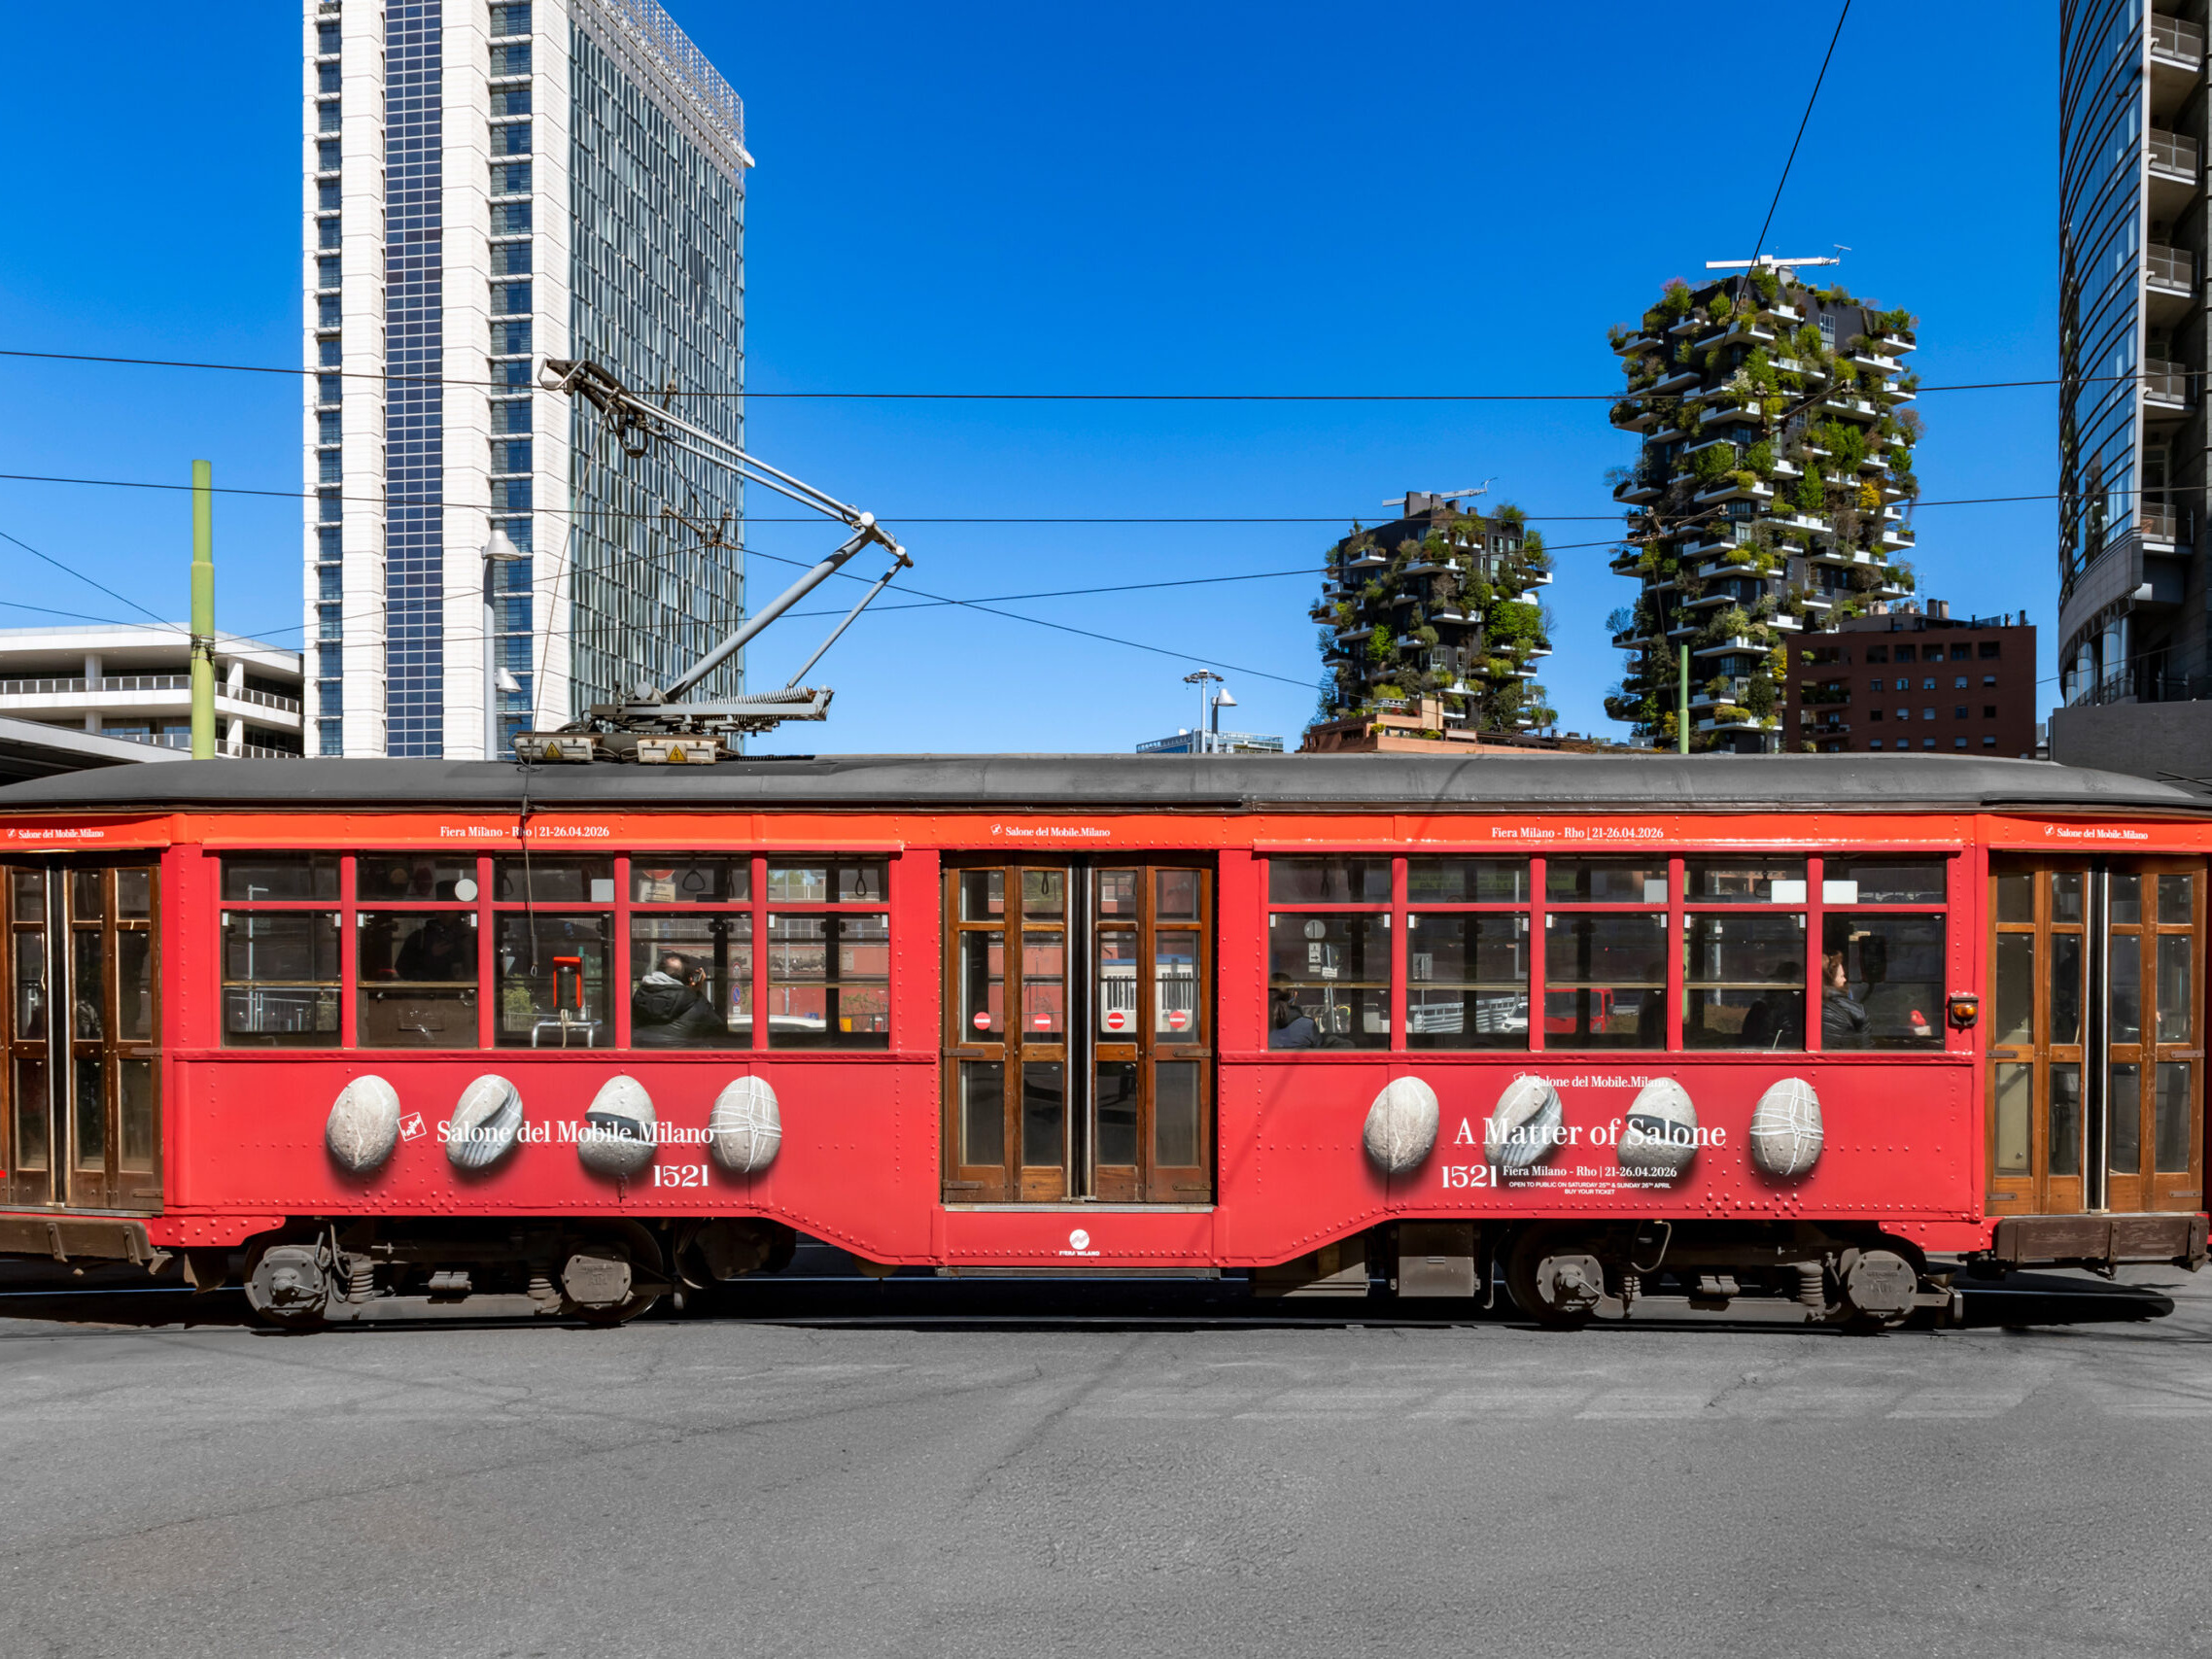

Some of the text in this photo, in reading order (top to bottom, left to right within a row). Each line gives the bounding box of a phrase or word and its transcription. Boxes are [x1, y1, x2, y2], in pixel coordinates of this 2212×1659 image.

[18, 828, 104, 839] Salone del Mobile.Milano
[440, 826, 466, 837] Fiera
[468, 826, 503, 837] Milano
[539, 826, 609, 837] 21-26.04.2026
[1006, 826, 1111, 837] Salone del Mobile.Milano
[1492, 827, 1518, 838] Fiera
[1520, 827, 1555, 838] Milano
[1564, 827, 1585, 838] Rho
[1592, 827, 1664, 838] 21-26.04.2026
[2056, 828, 2149, 840] Salone del Mobile.Milano
[1535, 1075, 1670, 1089] Salone del Mobile.Milano
[436, 1120, 512, 1143] Salone
[516, 1121, 551, 1143] del
[556, 1121, 714, 1144] Mobile.Milano
[1453, 1118, 1727, 1147] A Matter of Salone
[653, 1164, 709, 1188] 1521
[1441, 1164, 1498, 1189] 1521
[1503, 1166, 1529, 1177] Fiera
[1532, 1166, 1567, 1177] Milano
[1576, 1166, 1598, 1177] Rho
[1605, 1166, 1677, 1178] 21-26.04.2026
